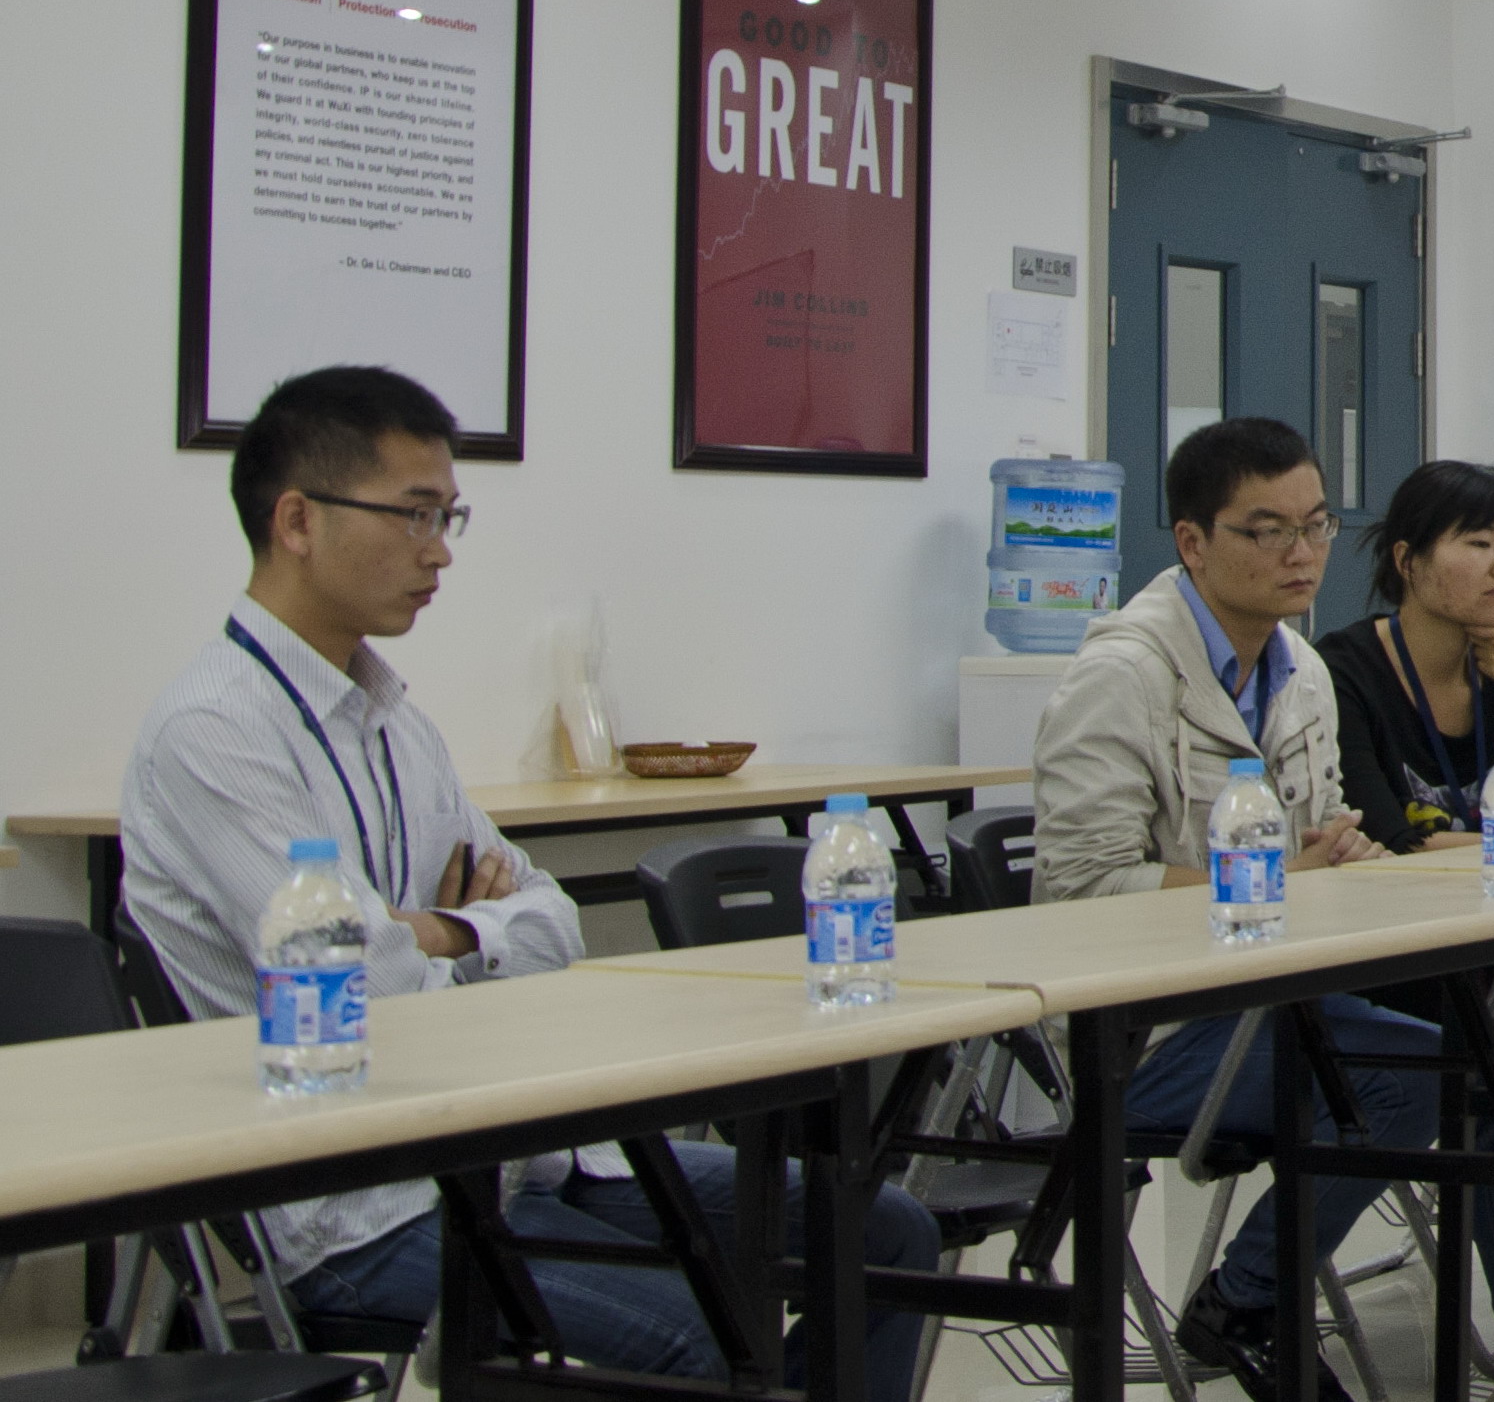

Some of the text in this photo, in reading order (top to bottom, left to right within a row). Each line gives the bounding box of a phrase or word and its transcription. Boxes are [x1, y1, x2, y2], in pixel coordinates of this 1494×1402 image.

[414, 10, 478, 32] rosecution
[282, 37, 320, 51] purpose
[323, 42, 331, 53] in
[335, 44, 374, 60] business
[377, 51, 384, 61] is
[388, 53, 396, 63] to
[399, 56, 428, 68] enable
[431, 60, 475, 76] innovation
[739, 11, 889, 68] GOOD TO
[256, 70, 266, 80] of
[271, 72, 293, 84] their
[360, 85, 369, 96] IP
[373, 87, 381, 98] is
[385, 90, 400, 100] our
[405, 93, 437, 106] shared
[257, 50, 270, 62] for
[274, 54, 289, 65] our
[294, 57, 322, 70] global
[371, 69, 389, 80] who
[392, 71, 414, 87] keep
[417, 77, 428, 87] us
[431, 79, 440, 88] at
[443, 80, 457, 91] the
[461, 83, 475, 96] top
[256, 88, 271, 100] We
[275, 93, 301, 105] guard
[305, 95, 311, 106] it
[315, 98, 324, 108] at
[355, 104, 373, 115] with
[376, 106, 416, 123] founding
[465, 119, 474, 129] of
[706, 48, 913, 199] GREAT
[303, 116, 359, 132] world-class
[407, 131, 427, 141] zero
[254, 149, 271, 161] any
[335, 157, 354, 169] This
[357, 160, 364, 171] is
[368, 163, 382, 173] our
[386, 164, 418, 177] highest
[457, 174, 473, 184] and
[297, 135, 314, 145] and
[364, 144, 395, 156] pursuit
[398, 147, 407, 157] of
[410, 149, 439, 161] justice
[442, 154, 473, 166] against
[254, 168, 268, 178] we
[273, 170, 297, 181] must
[301, 172, 322, 184] hold
[326, 177, 372, 190] ourselves
[440, 189, 454, 200] We
[458, 193, 472, 202] are
[253, 186, 472, 222] determined to earn the trust of our partners by
[253, 207, 305, 223] committing
[308, 212, 317, 222] to
[320, 214, 356, 226] success
[346, 256, 358, 267] Dr.
[361, 258, 373, 269] Ge
[389, 260, 431, 274] Chairman
[433, 266, 450, 276] and
[452, 267, 472, 278] CEO
[753, 289, 868, 317] JIM COLLINS
